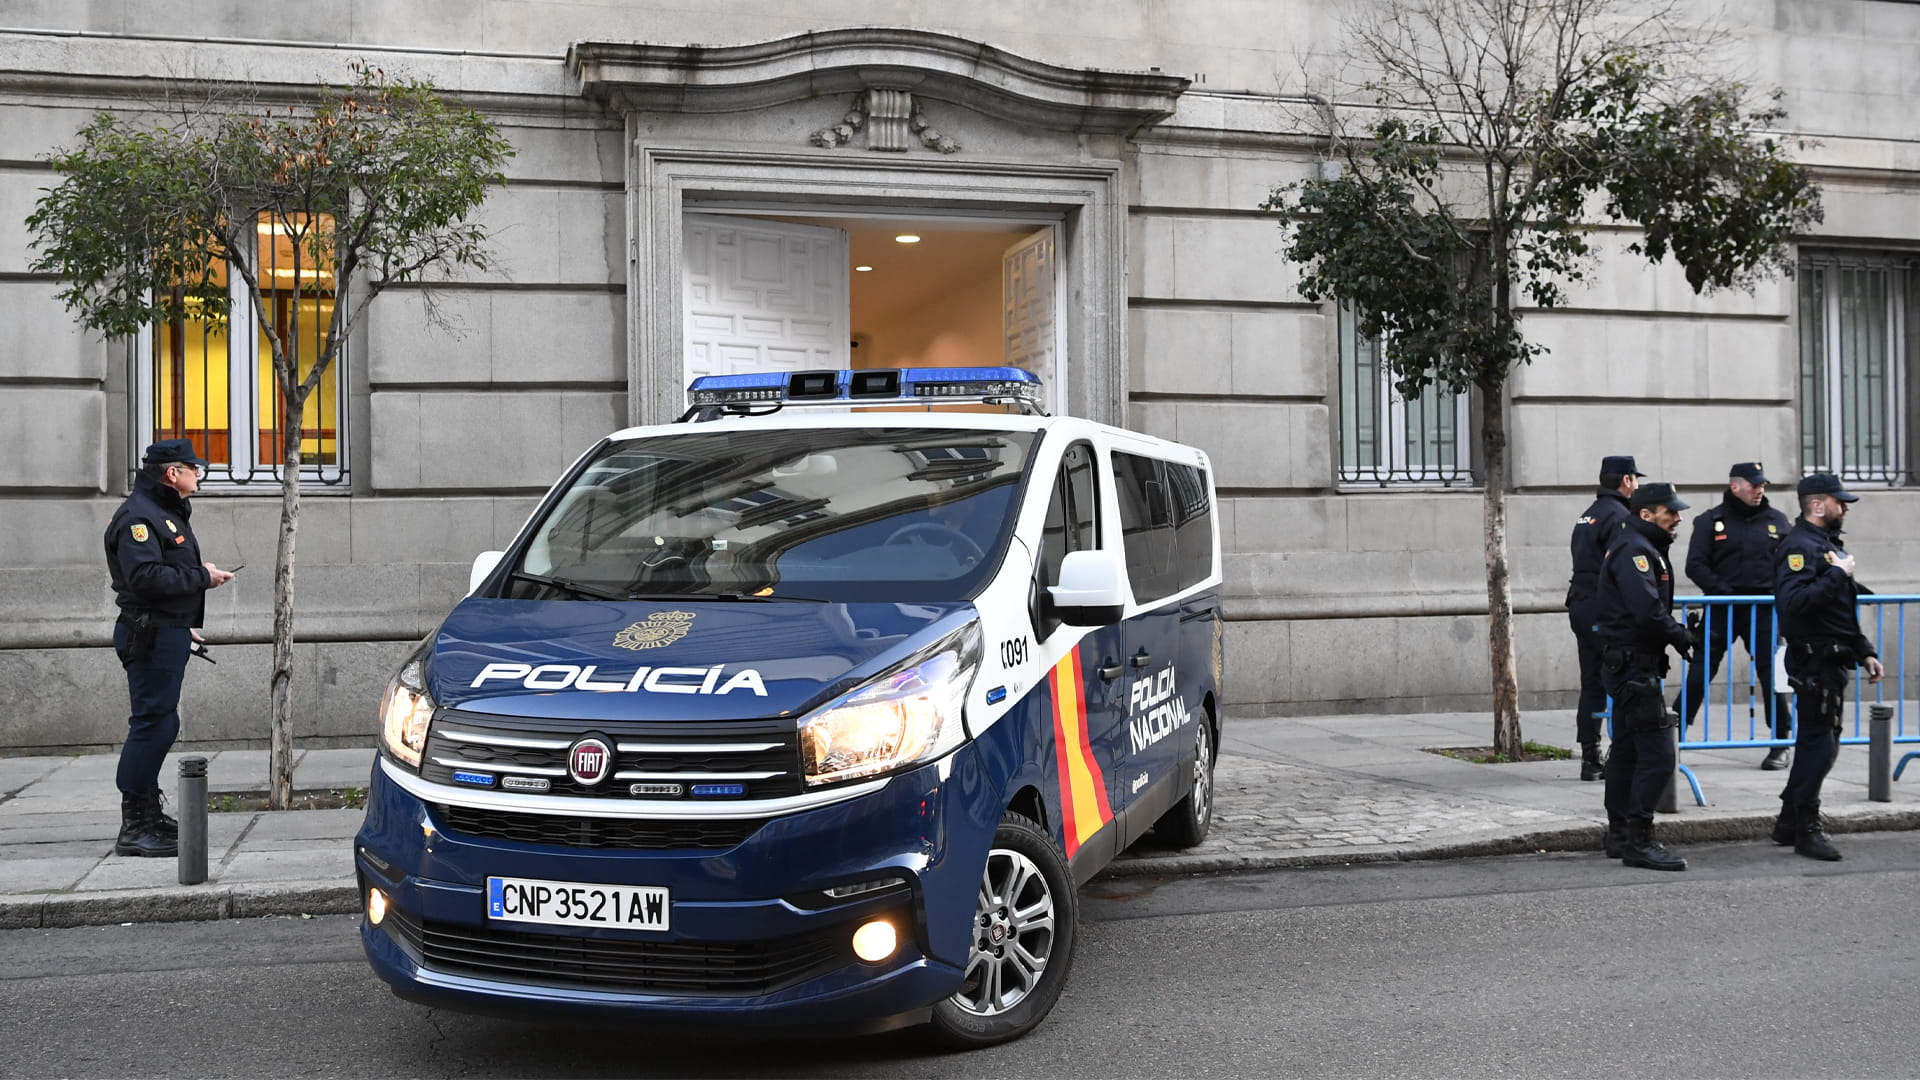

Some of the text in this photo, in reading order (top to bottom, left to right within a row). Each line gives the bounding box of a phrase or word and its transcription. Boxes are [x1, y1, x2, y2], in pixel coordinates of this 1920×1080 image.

[470, 663, 768, 696] POLICÍA
[1130, 660, 1176, 717] POLICÍA
[1129, 695, 1191, 756] NACIONAL
[578, 752, 602, 773] FIAT
[493, 902, 500, 912] E
